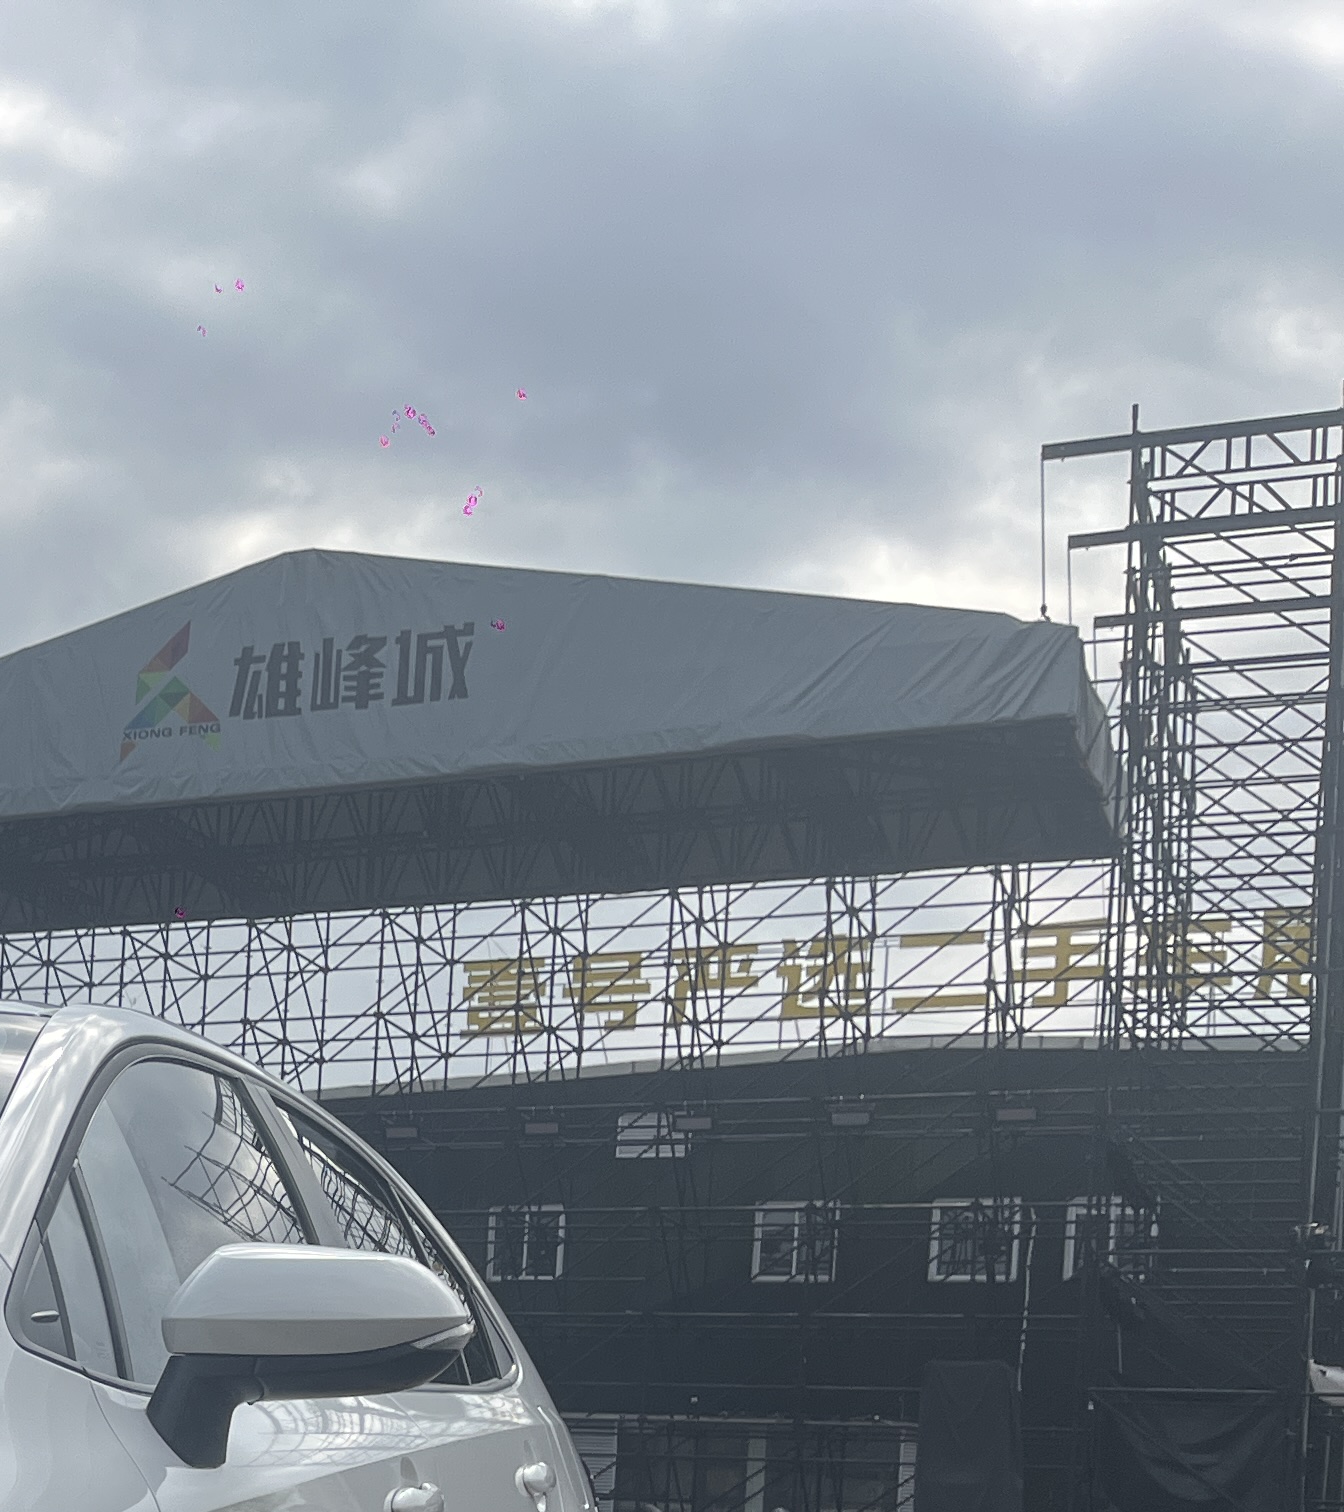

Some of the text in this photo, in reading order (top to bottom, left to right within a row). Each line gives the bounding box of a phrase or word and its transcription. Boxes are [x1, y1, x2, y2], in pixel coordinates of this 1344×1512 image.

[228, 621, 475, 720] 雄峰城
[123, 722, 222, 742] XIONG FENG
